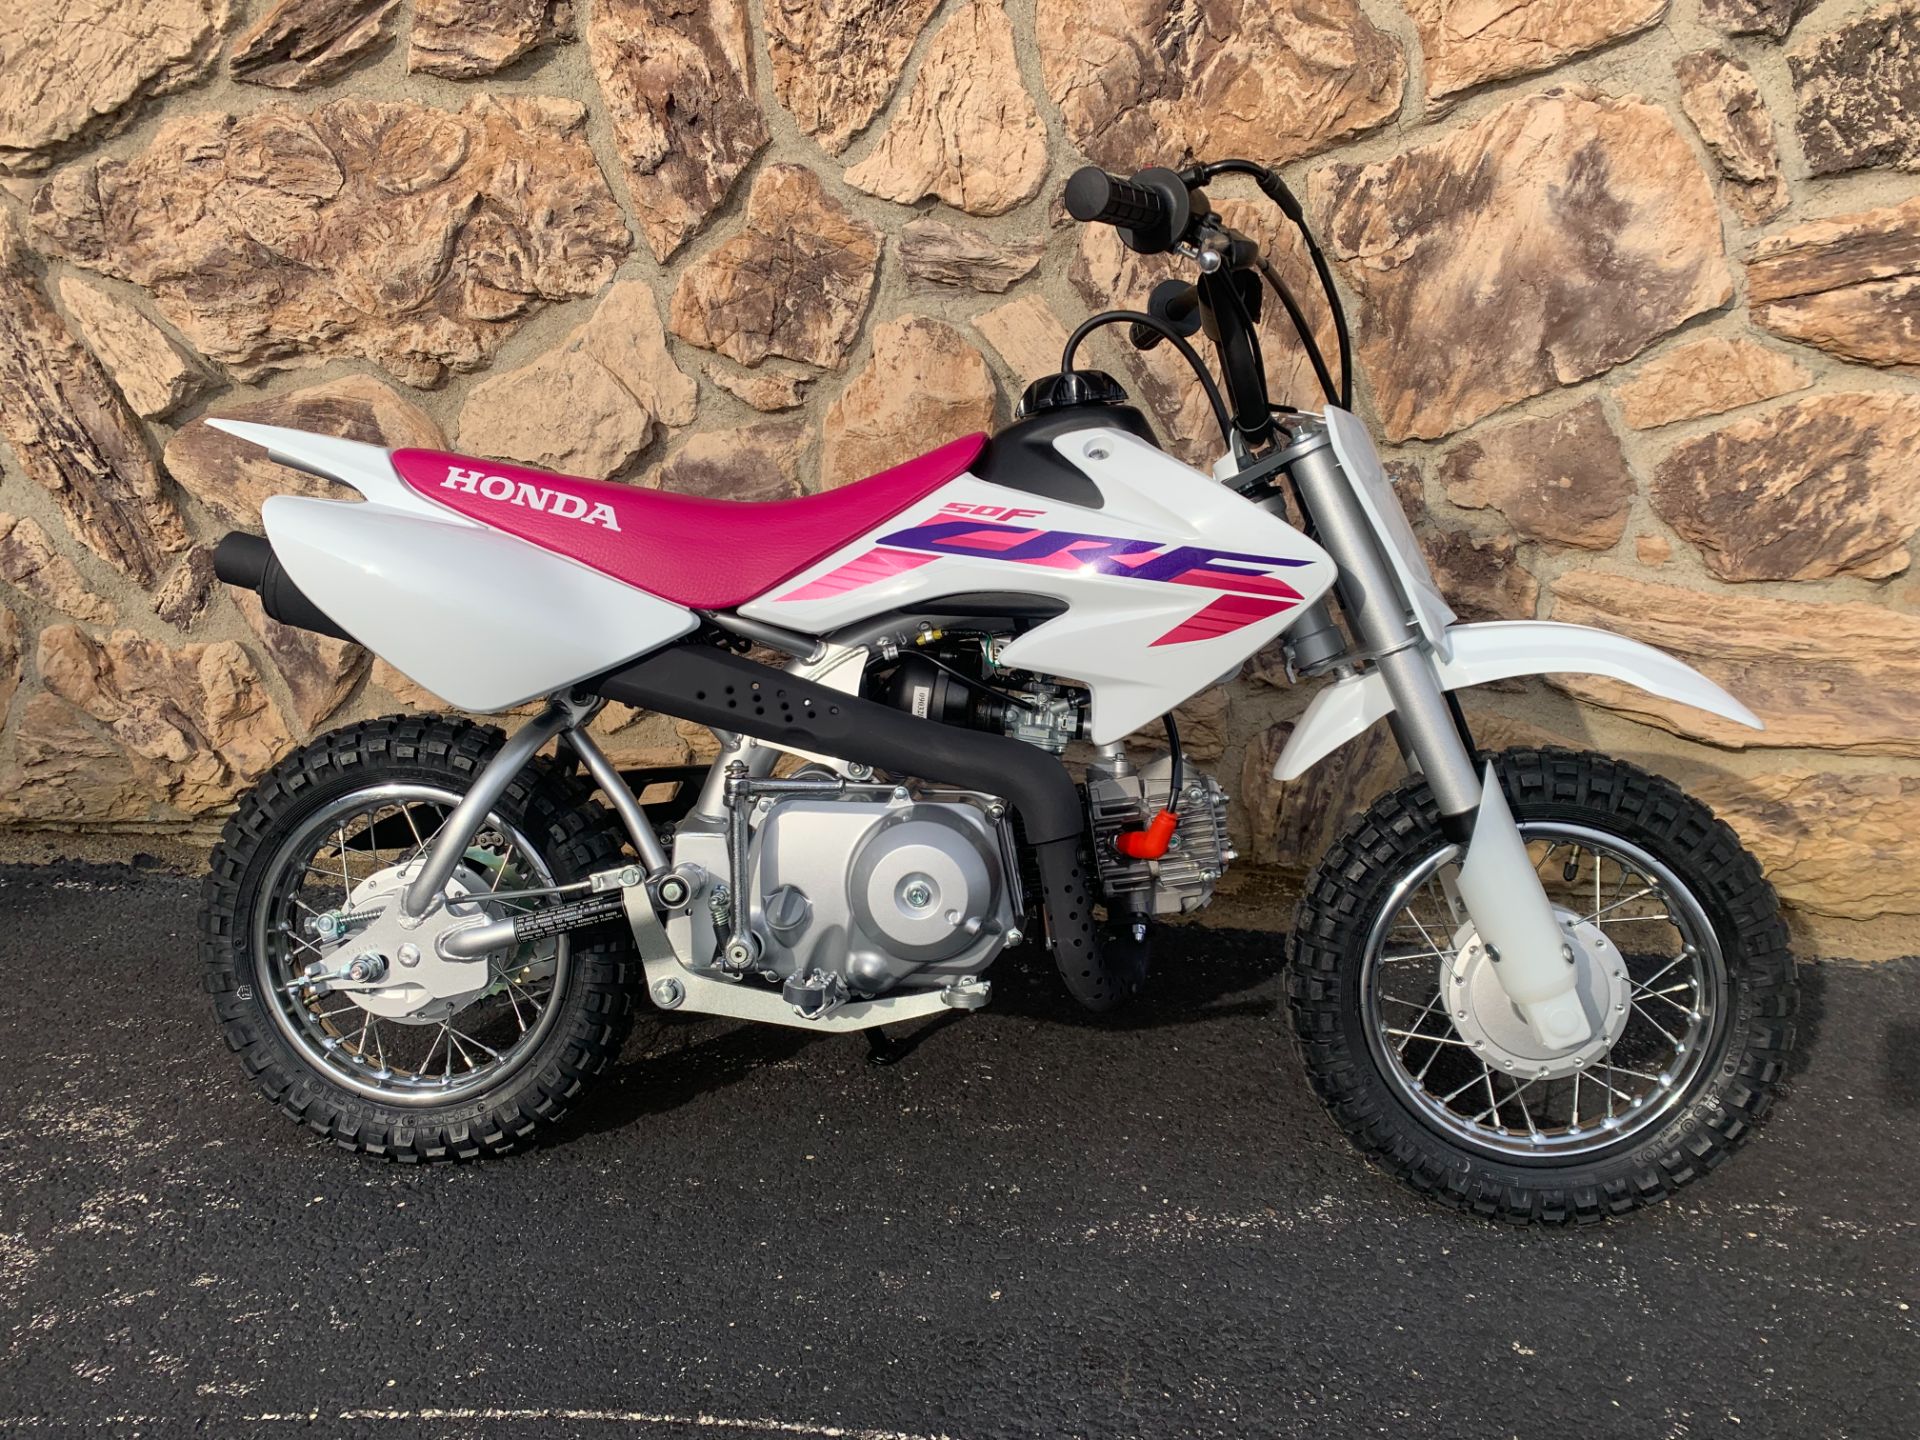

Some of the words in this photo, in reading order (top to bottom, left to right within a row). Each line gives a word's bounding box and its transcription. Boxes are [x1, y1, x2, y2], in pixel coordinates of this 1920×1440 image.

[440, 466, 621, 532] HONDA
[938, 502, 1048, 521] 50F
[876, 521, 1316, 582] CRF
